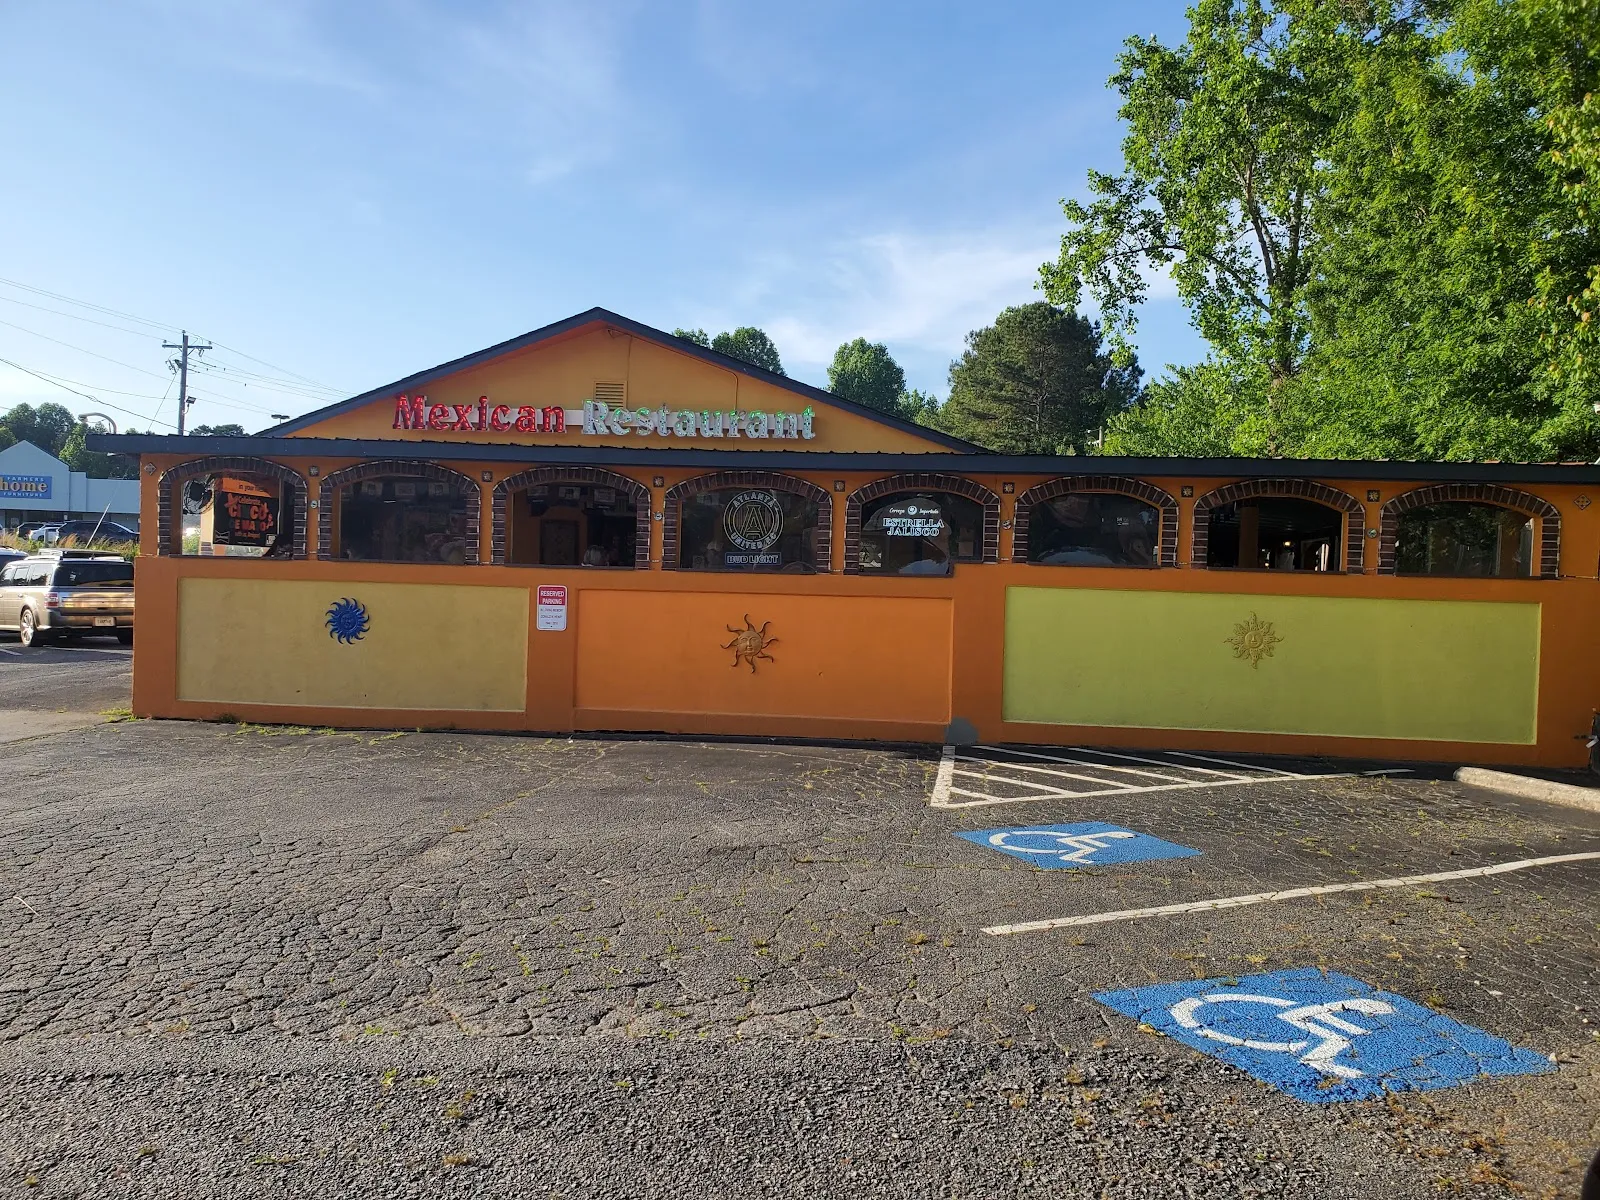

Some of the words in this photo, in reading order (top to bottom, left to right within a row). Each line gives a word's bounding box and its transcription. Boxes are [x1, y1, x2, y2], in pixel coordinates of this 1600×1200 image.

[392, 395, 568, 433] Mexican
[580, 398, 816, 440] Restaurant
[0, 475, 48, 492] home
[733, 491, 774, 508] ATLANTA
[882, 517, 945, 528] ESTRELLA
[886, 526, 940, 537] JALISCO
[730, 532, 763, 550] UNITED
[727, 555, 748, 564] BUD
[749, 554, 779, 564] LIGHT
